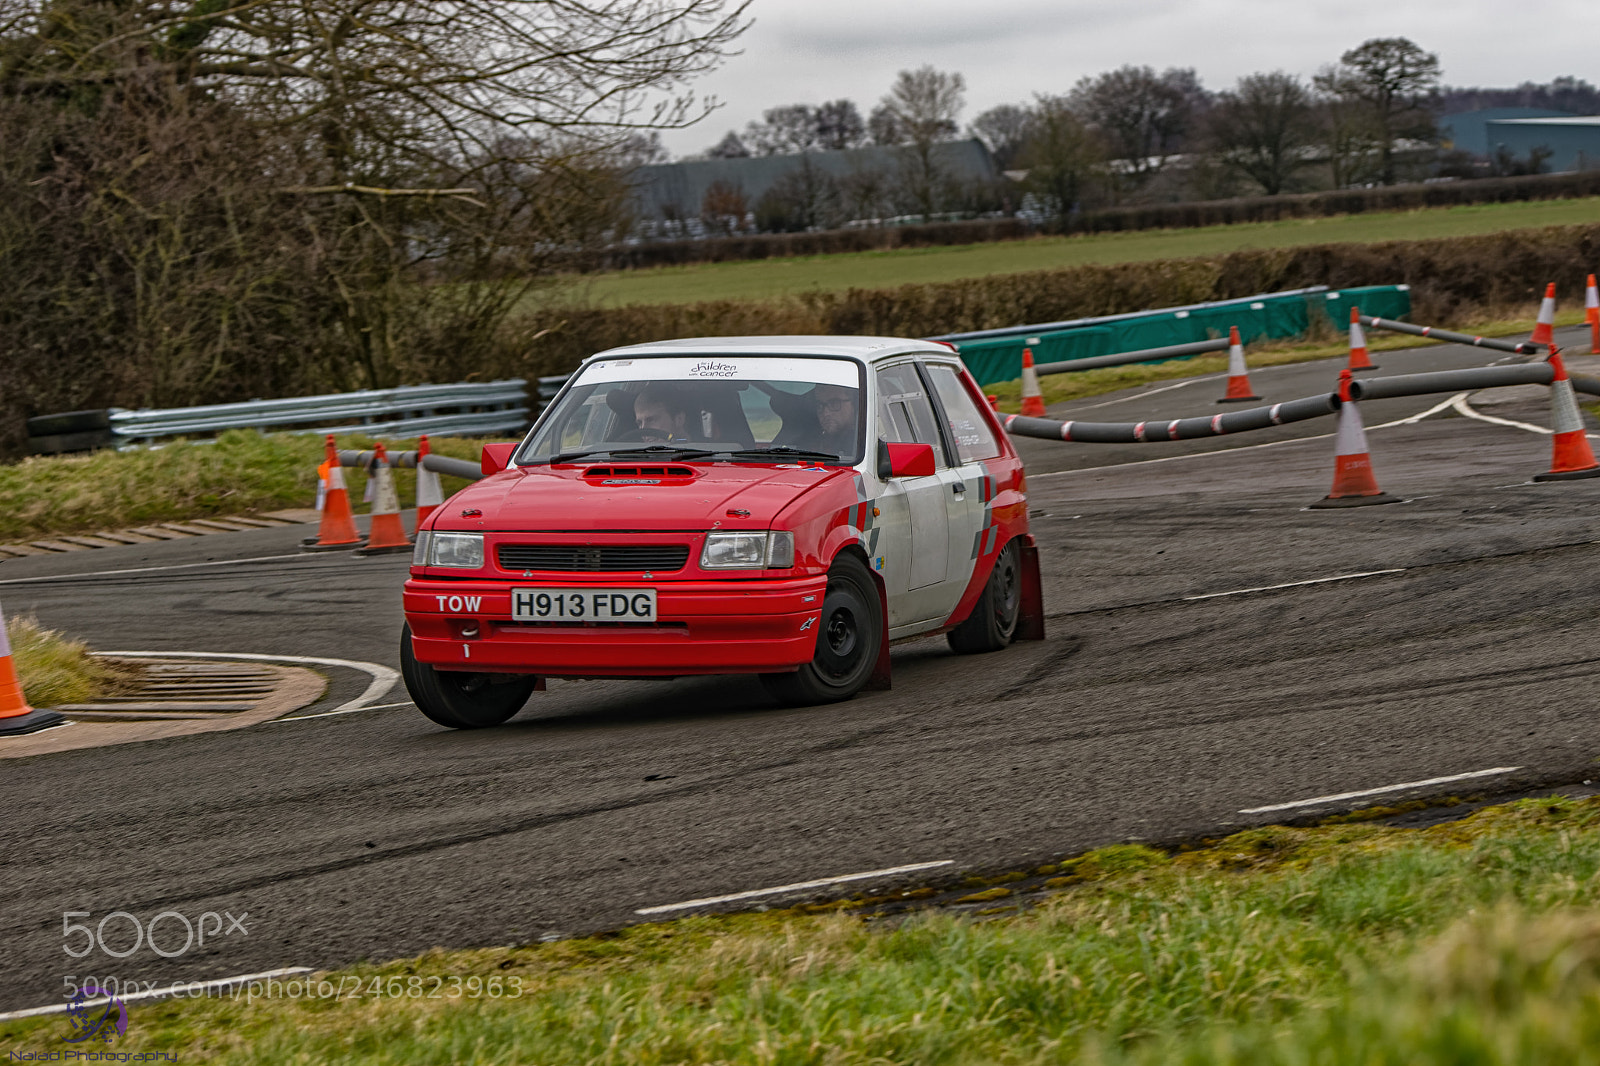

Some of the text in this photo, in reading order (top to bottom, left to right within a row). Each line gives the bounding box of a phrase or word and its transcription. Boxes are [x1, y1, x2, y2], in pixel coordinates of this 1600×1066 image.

[691, 361, 737, 373] children
[435, 595, 482, 612] TOW
[516, 593, 652, 617] H913 FDG
